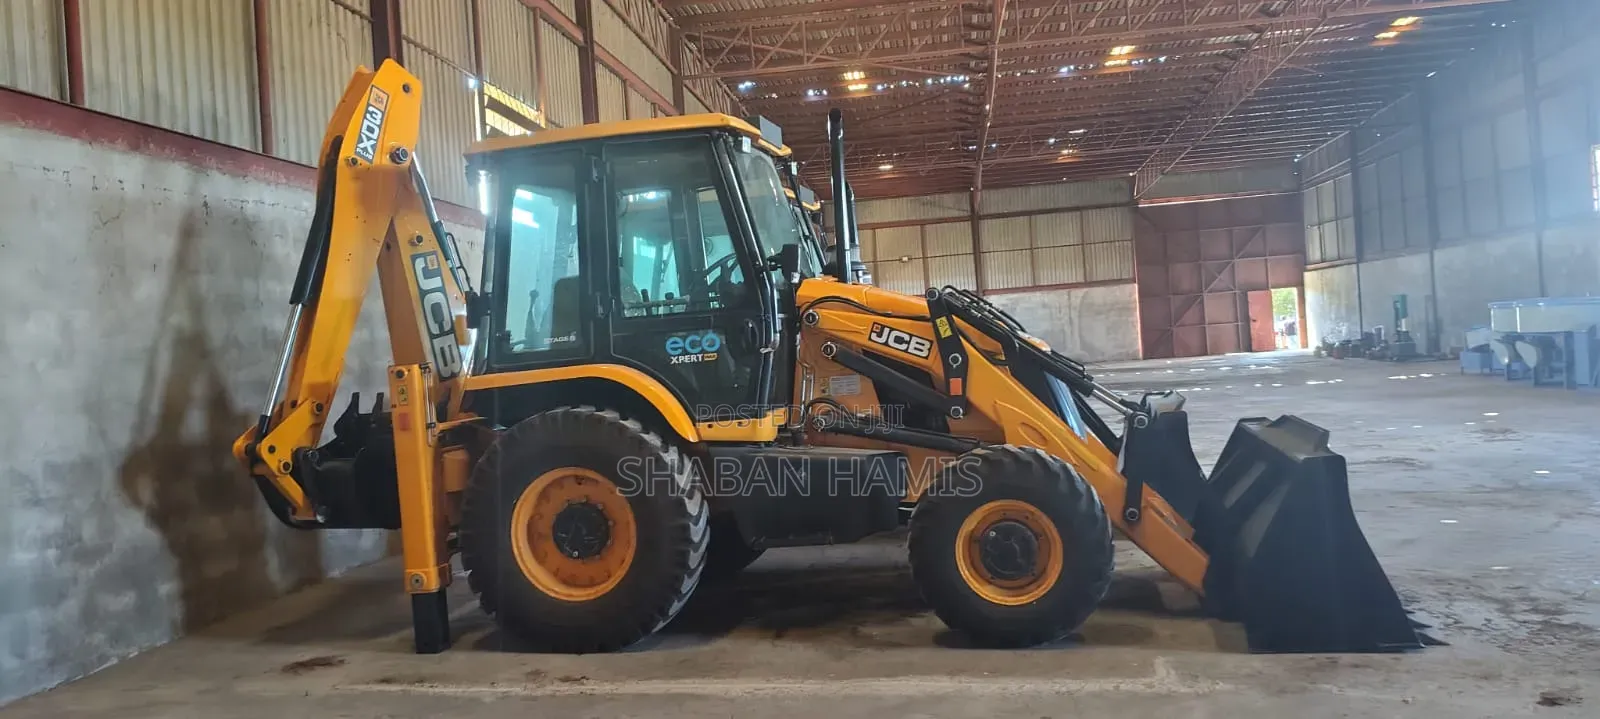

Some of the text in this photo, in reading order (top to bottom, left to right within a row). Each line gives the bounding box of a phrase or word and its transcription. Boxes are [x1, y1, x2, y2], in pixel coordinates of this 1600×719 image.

[357, 105, 383, 155] 3DX
[356, 147, 373, 160] PLUS
[414, 257, 462, 378] JCB
[665, 330, 720, 356] eco
[870, 326, 931, 358] JCB
[670, 353, 703, 365] XPERT
